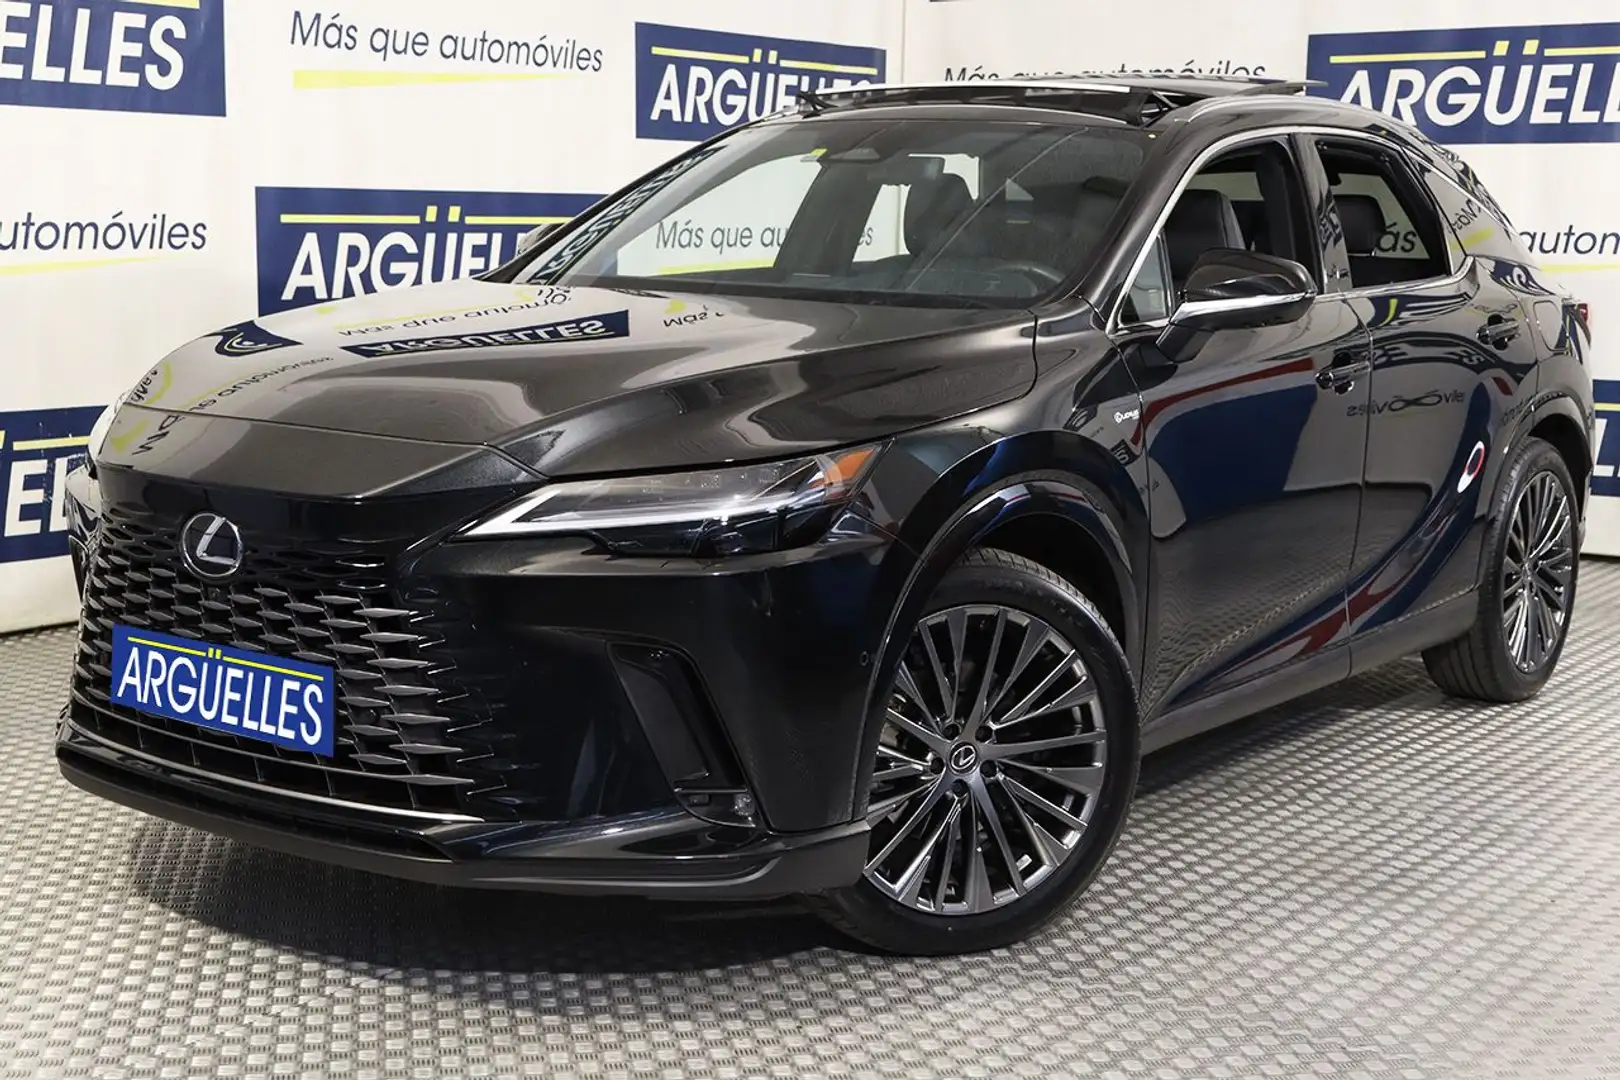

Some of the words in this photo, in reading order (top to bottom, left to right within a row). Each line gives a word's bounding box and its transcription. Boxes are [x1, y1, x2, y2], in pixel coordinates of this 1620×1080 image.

[0, 2, 187, 91] ELLES
[290, 11, 358, 51] Más
[369, 26, 429, 61] que
[439, 31, 603, 72] automóviles
[650, 48, 872, 125] ARGÜE
[655, 220, 704, 249] Más
[711, 226, 753, 254] que
[1376, 222, 1417, 253] ás
[117, 647, 324, 746] ARGÜELLES
